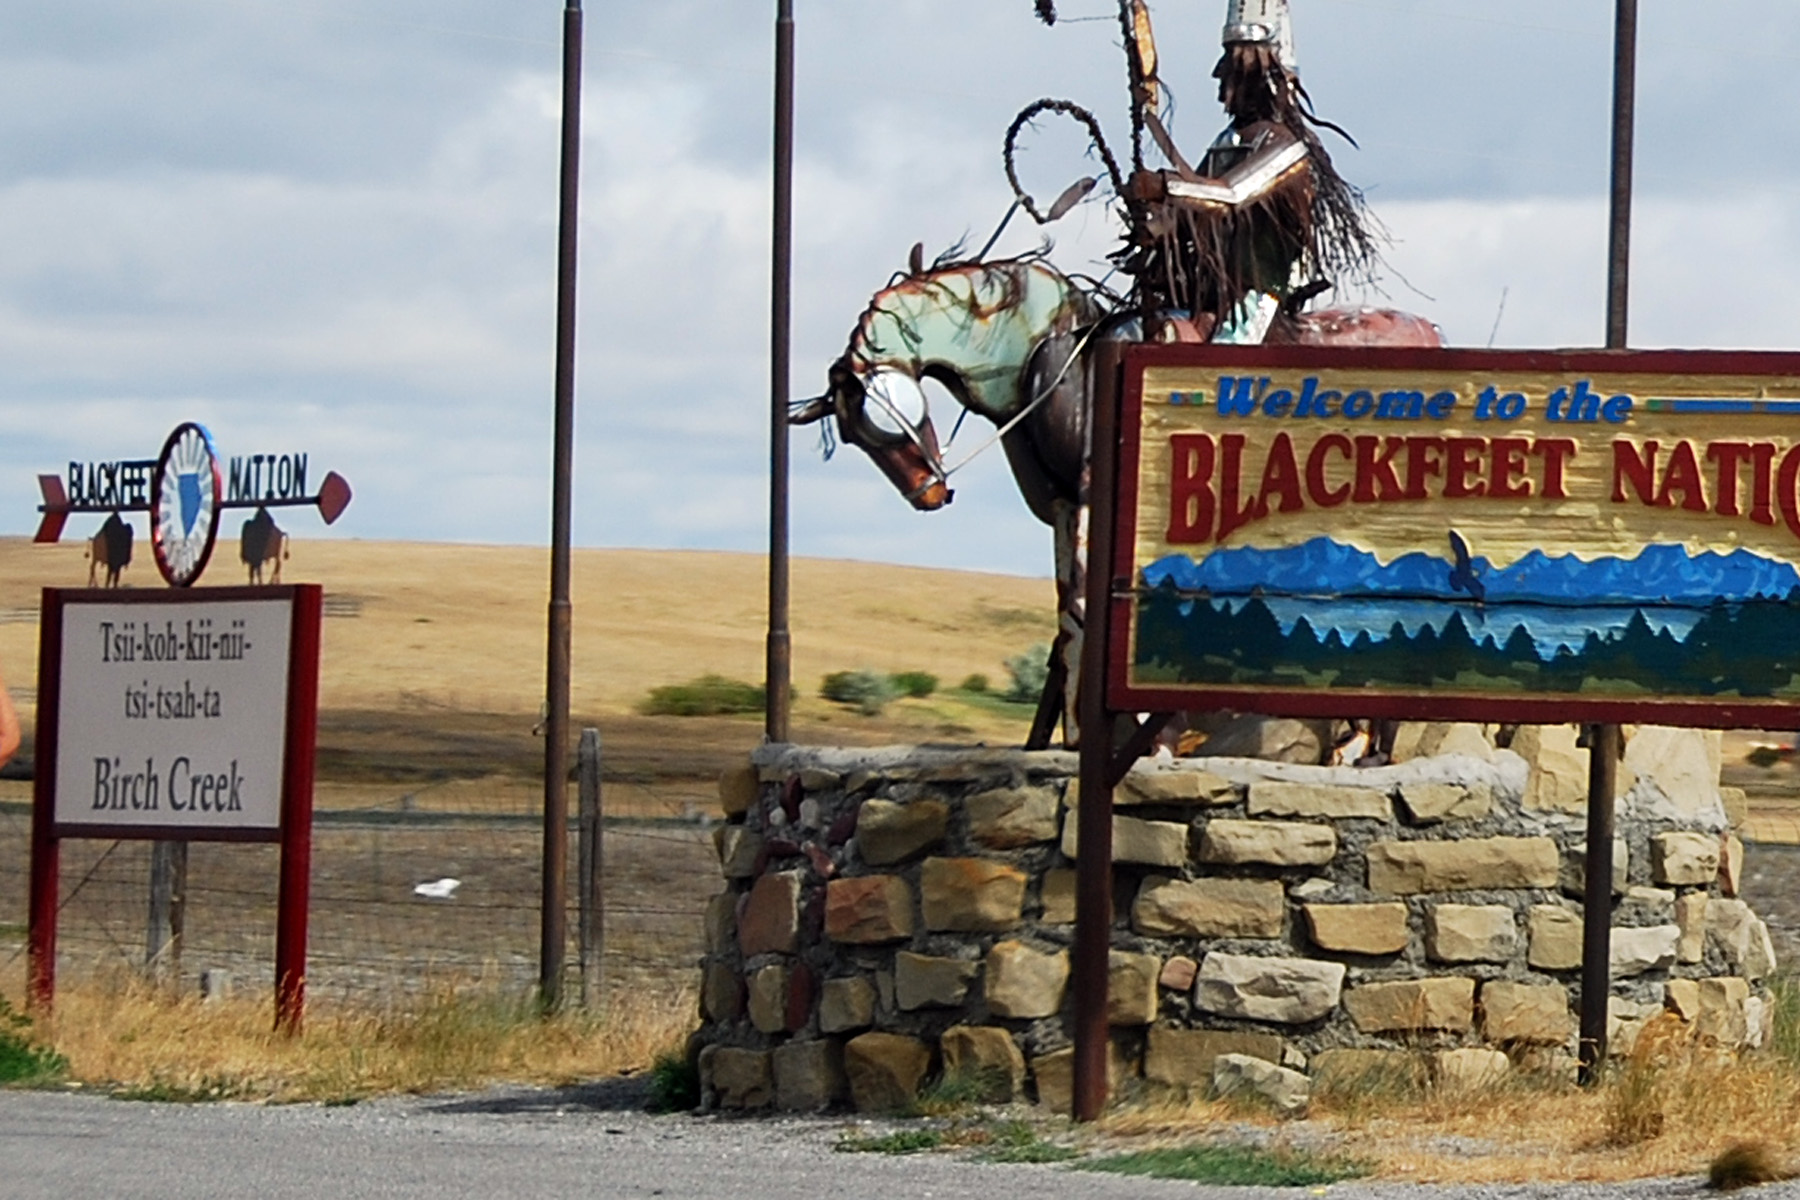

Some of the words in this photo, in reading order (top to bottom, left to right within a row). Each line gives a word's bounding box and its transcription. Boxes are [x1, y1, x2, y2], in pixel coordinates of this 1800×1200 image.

[1216, 375, 1458, 420] Welcome
[1474, 385, 1527, 420] to
[1545, 379, 1634, 423] the
[228, 452, 307, 501] NATION
[1166, 432, 1577, 543] BLACKFEET
[125, 679, 221, 719] tsi-tsah-ta
[92, 757, 158, 810] Birch
[168, 756, 244, 812] Creek
